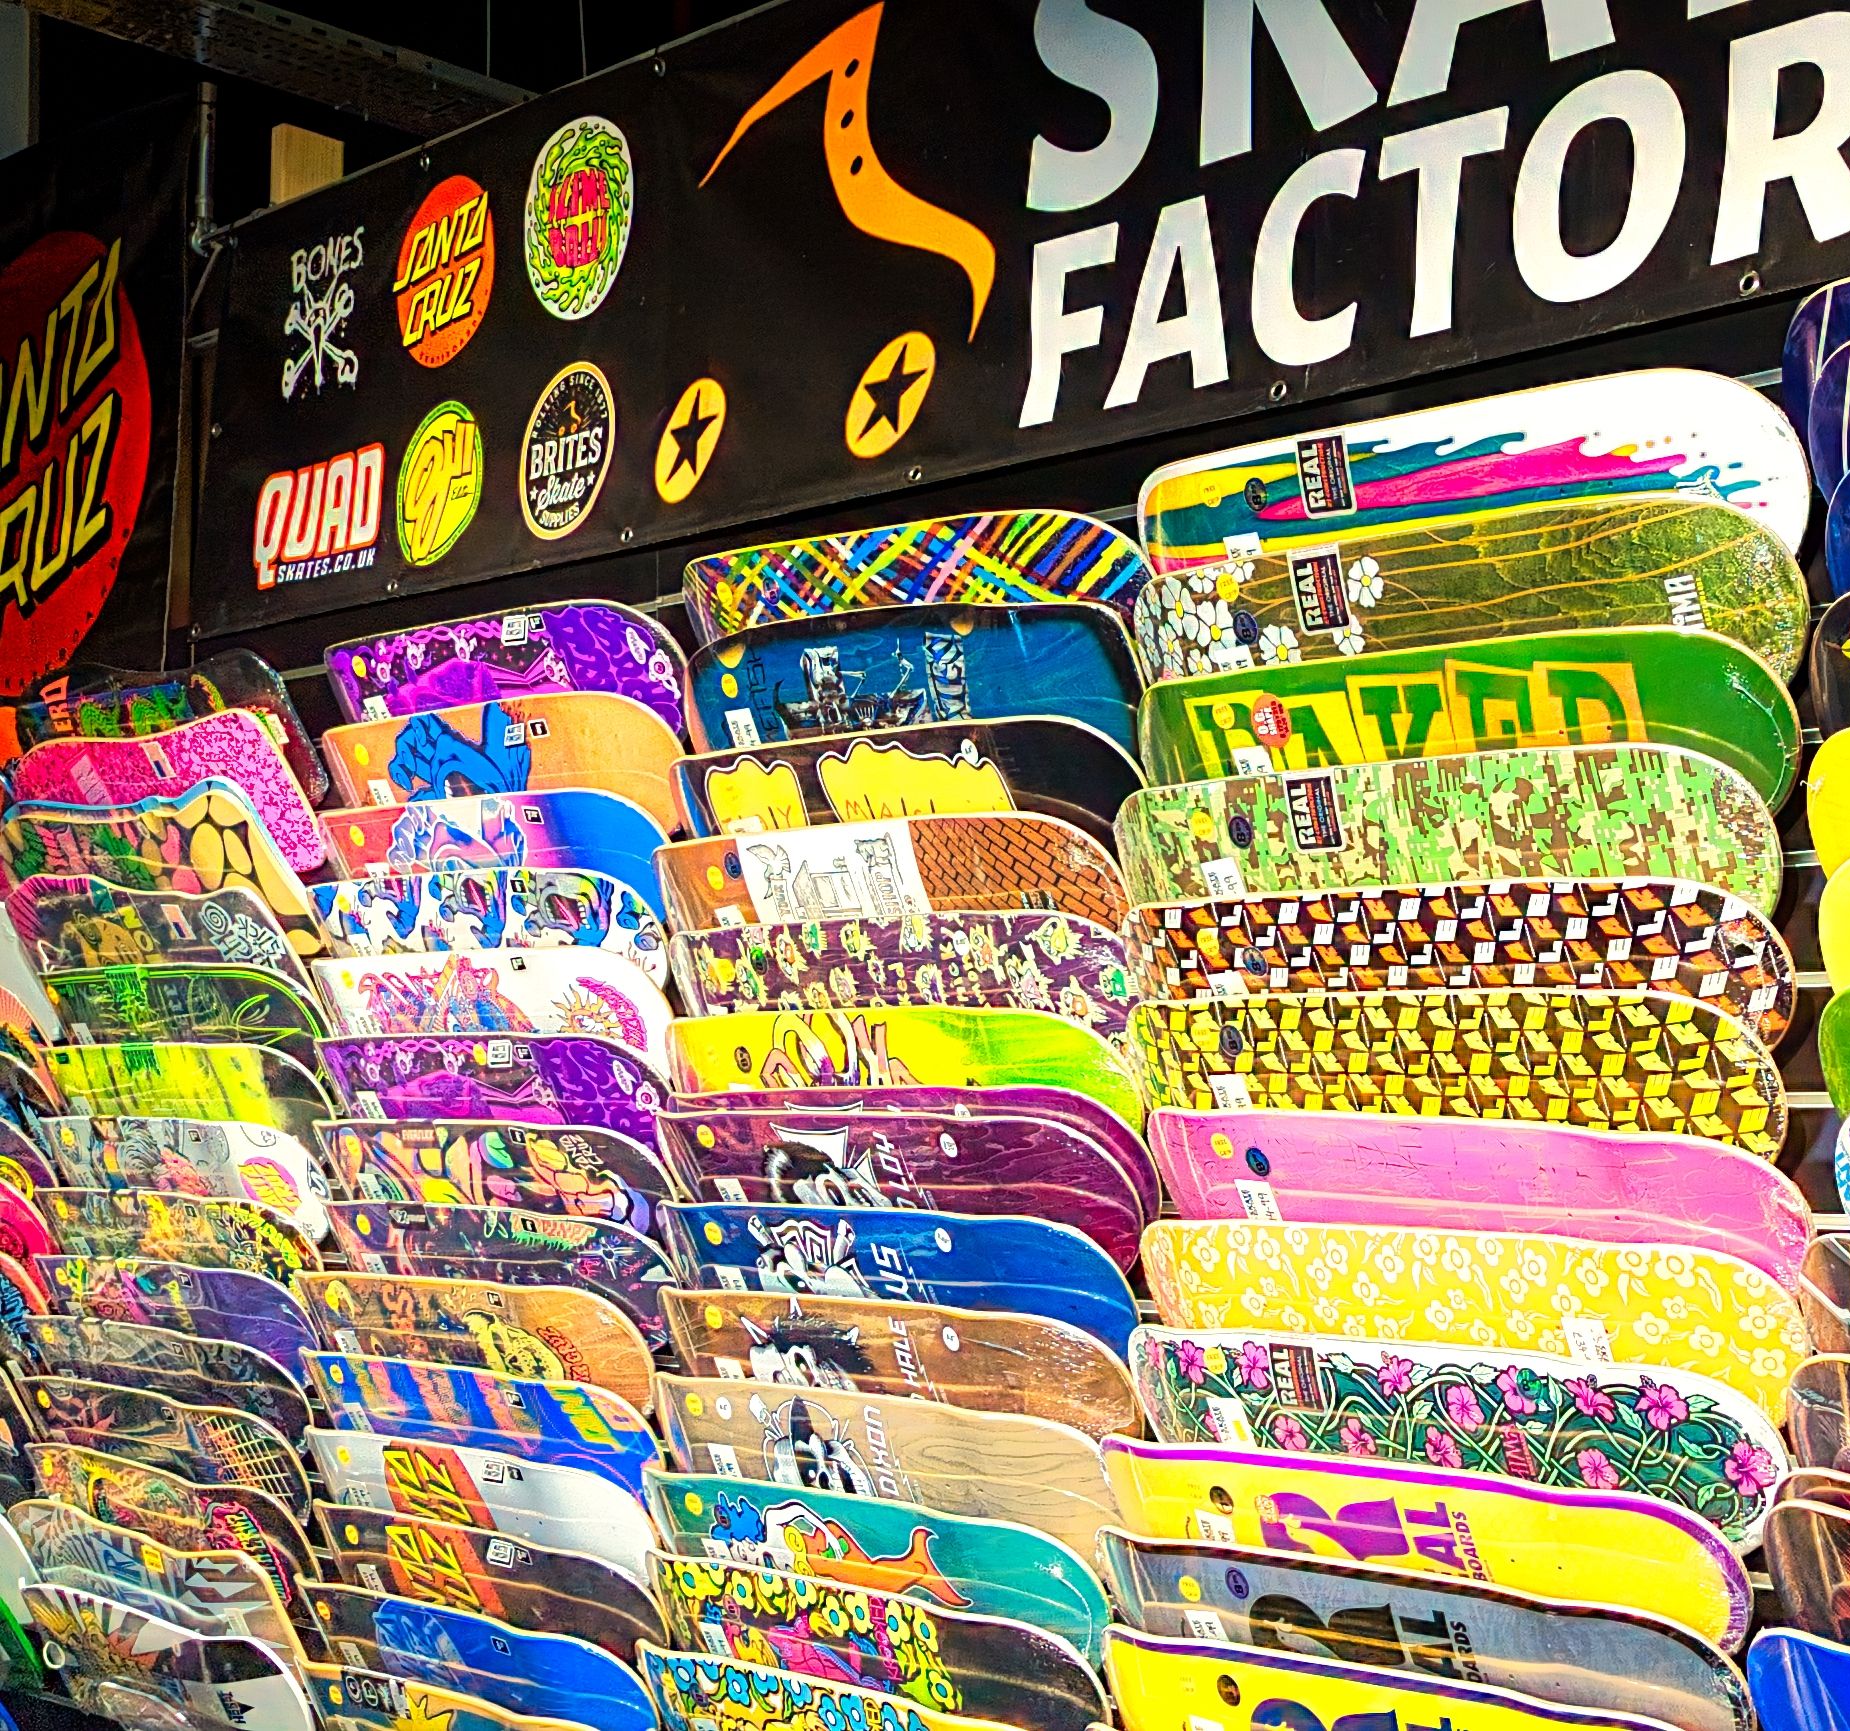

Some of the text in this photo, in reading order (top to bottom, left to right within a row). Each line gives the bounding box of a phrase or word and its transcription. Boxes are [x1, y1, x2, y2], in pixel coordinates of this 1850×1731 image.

[291, 225, 365, 293] BONES
[393, 191, 489, 293] SANTA
[403, 258, 482, 348] CRUZ
[569, 374, 595, 390] SINCE
[529, 426, 604, 481] BRITES
[1301, 443, 1327, 509] REAL
[254, 446, 384, 589] QUAD
[535, 472, 586, 516] Skate
[539, 502, 580, 529] SUPPLIES
[277, 547, 376, 584] SKATES.CO.UK
[1296, 561, 1324, 627] REAL
[1293, 783, 1318, 846] REAL
[1271, 1348, 1298, 1406] REAL
